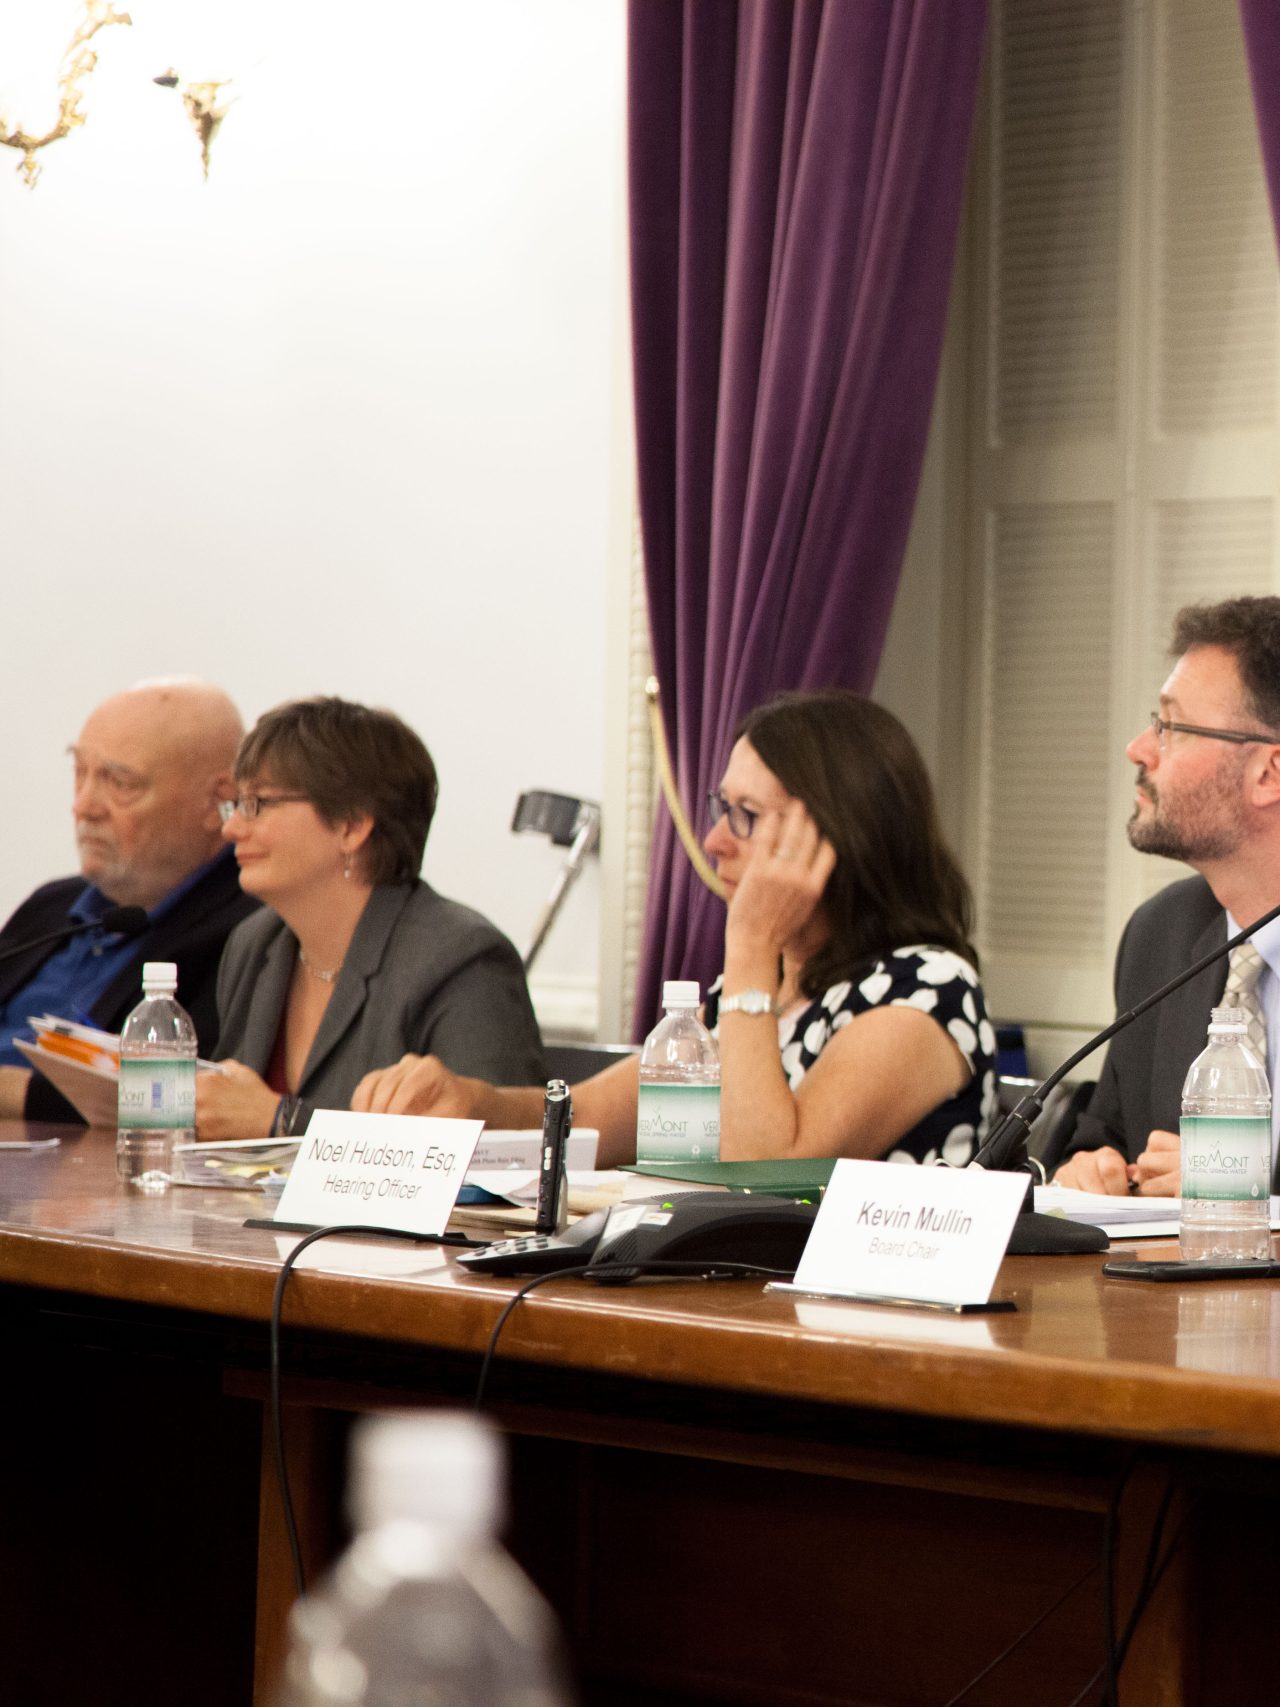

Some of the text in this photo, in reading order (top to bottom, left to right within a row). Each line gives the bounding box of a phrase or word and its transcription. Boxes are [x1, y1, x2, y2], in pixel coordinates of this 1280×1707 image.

[308, 1137, 457, 1177] Noel Hudson, Esq.
[1187, 1149, 1249, 1169] VERMONT
[322, 1173, 422, 1201] Hearing Officer
[857, 1201, 972, 1235] Kevin Mullin
[868, 1237, 940, 1260] Board Chair
